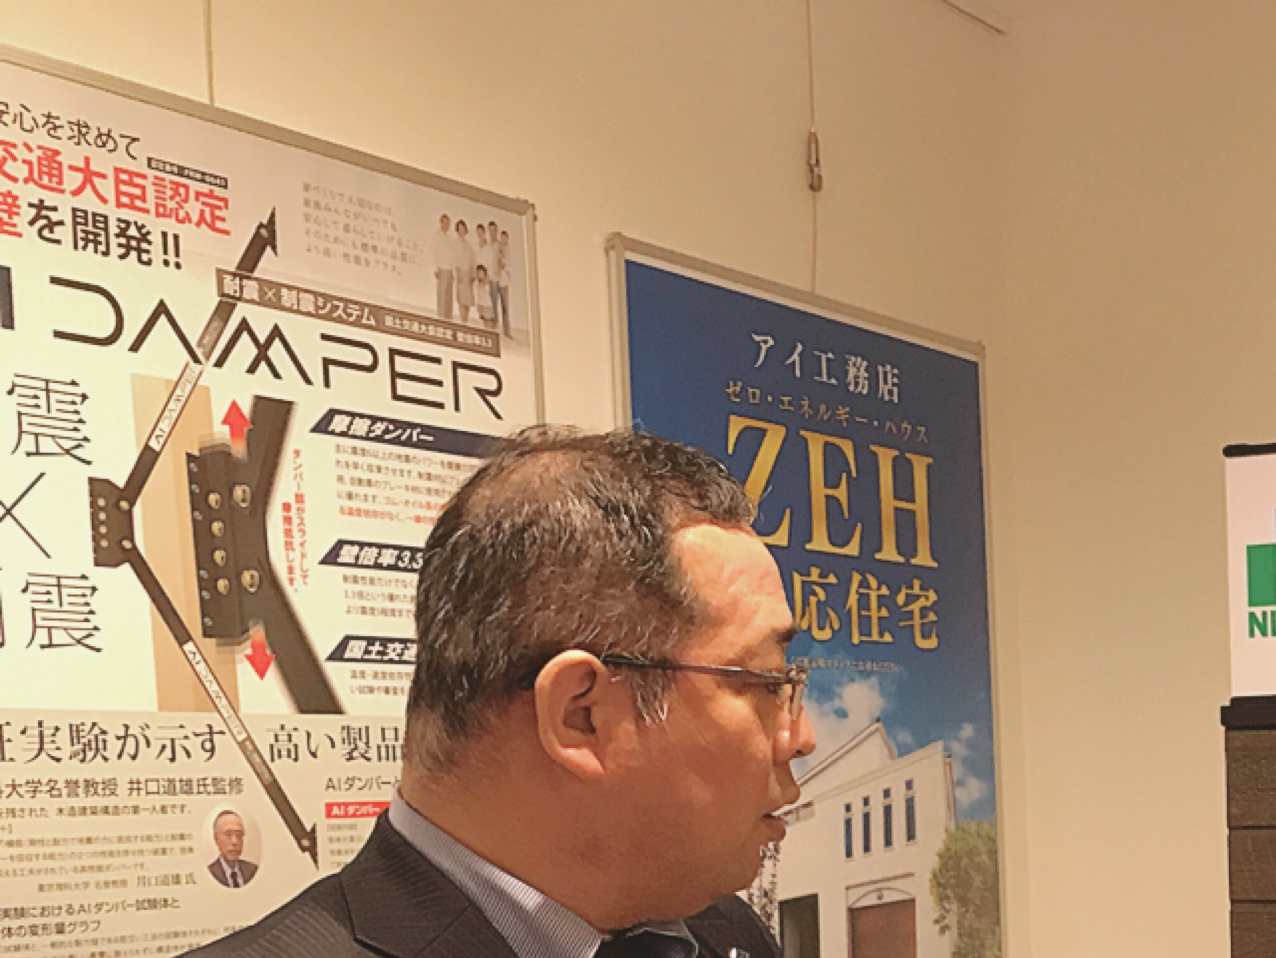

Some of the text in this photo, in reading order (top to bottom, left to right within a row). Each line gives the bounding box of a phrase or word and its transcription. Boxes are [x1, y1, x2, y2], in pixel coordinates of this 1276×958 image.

[751, 332, 900, 404] アイ工務店
[725, 381, 930, 444] ゼロ・エネルギー・ハウス
[727, 414, 938, 568] ZEH
[0, 777, 244, 799] 大学名誉教授 井口道雄氏監修
